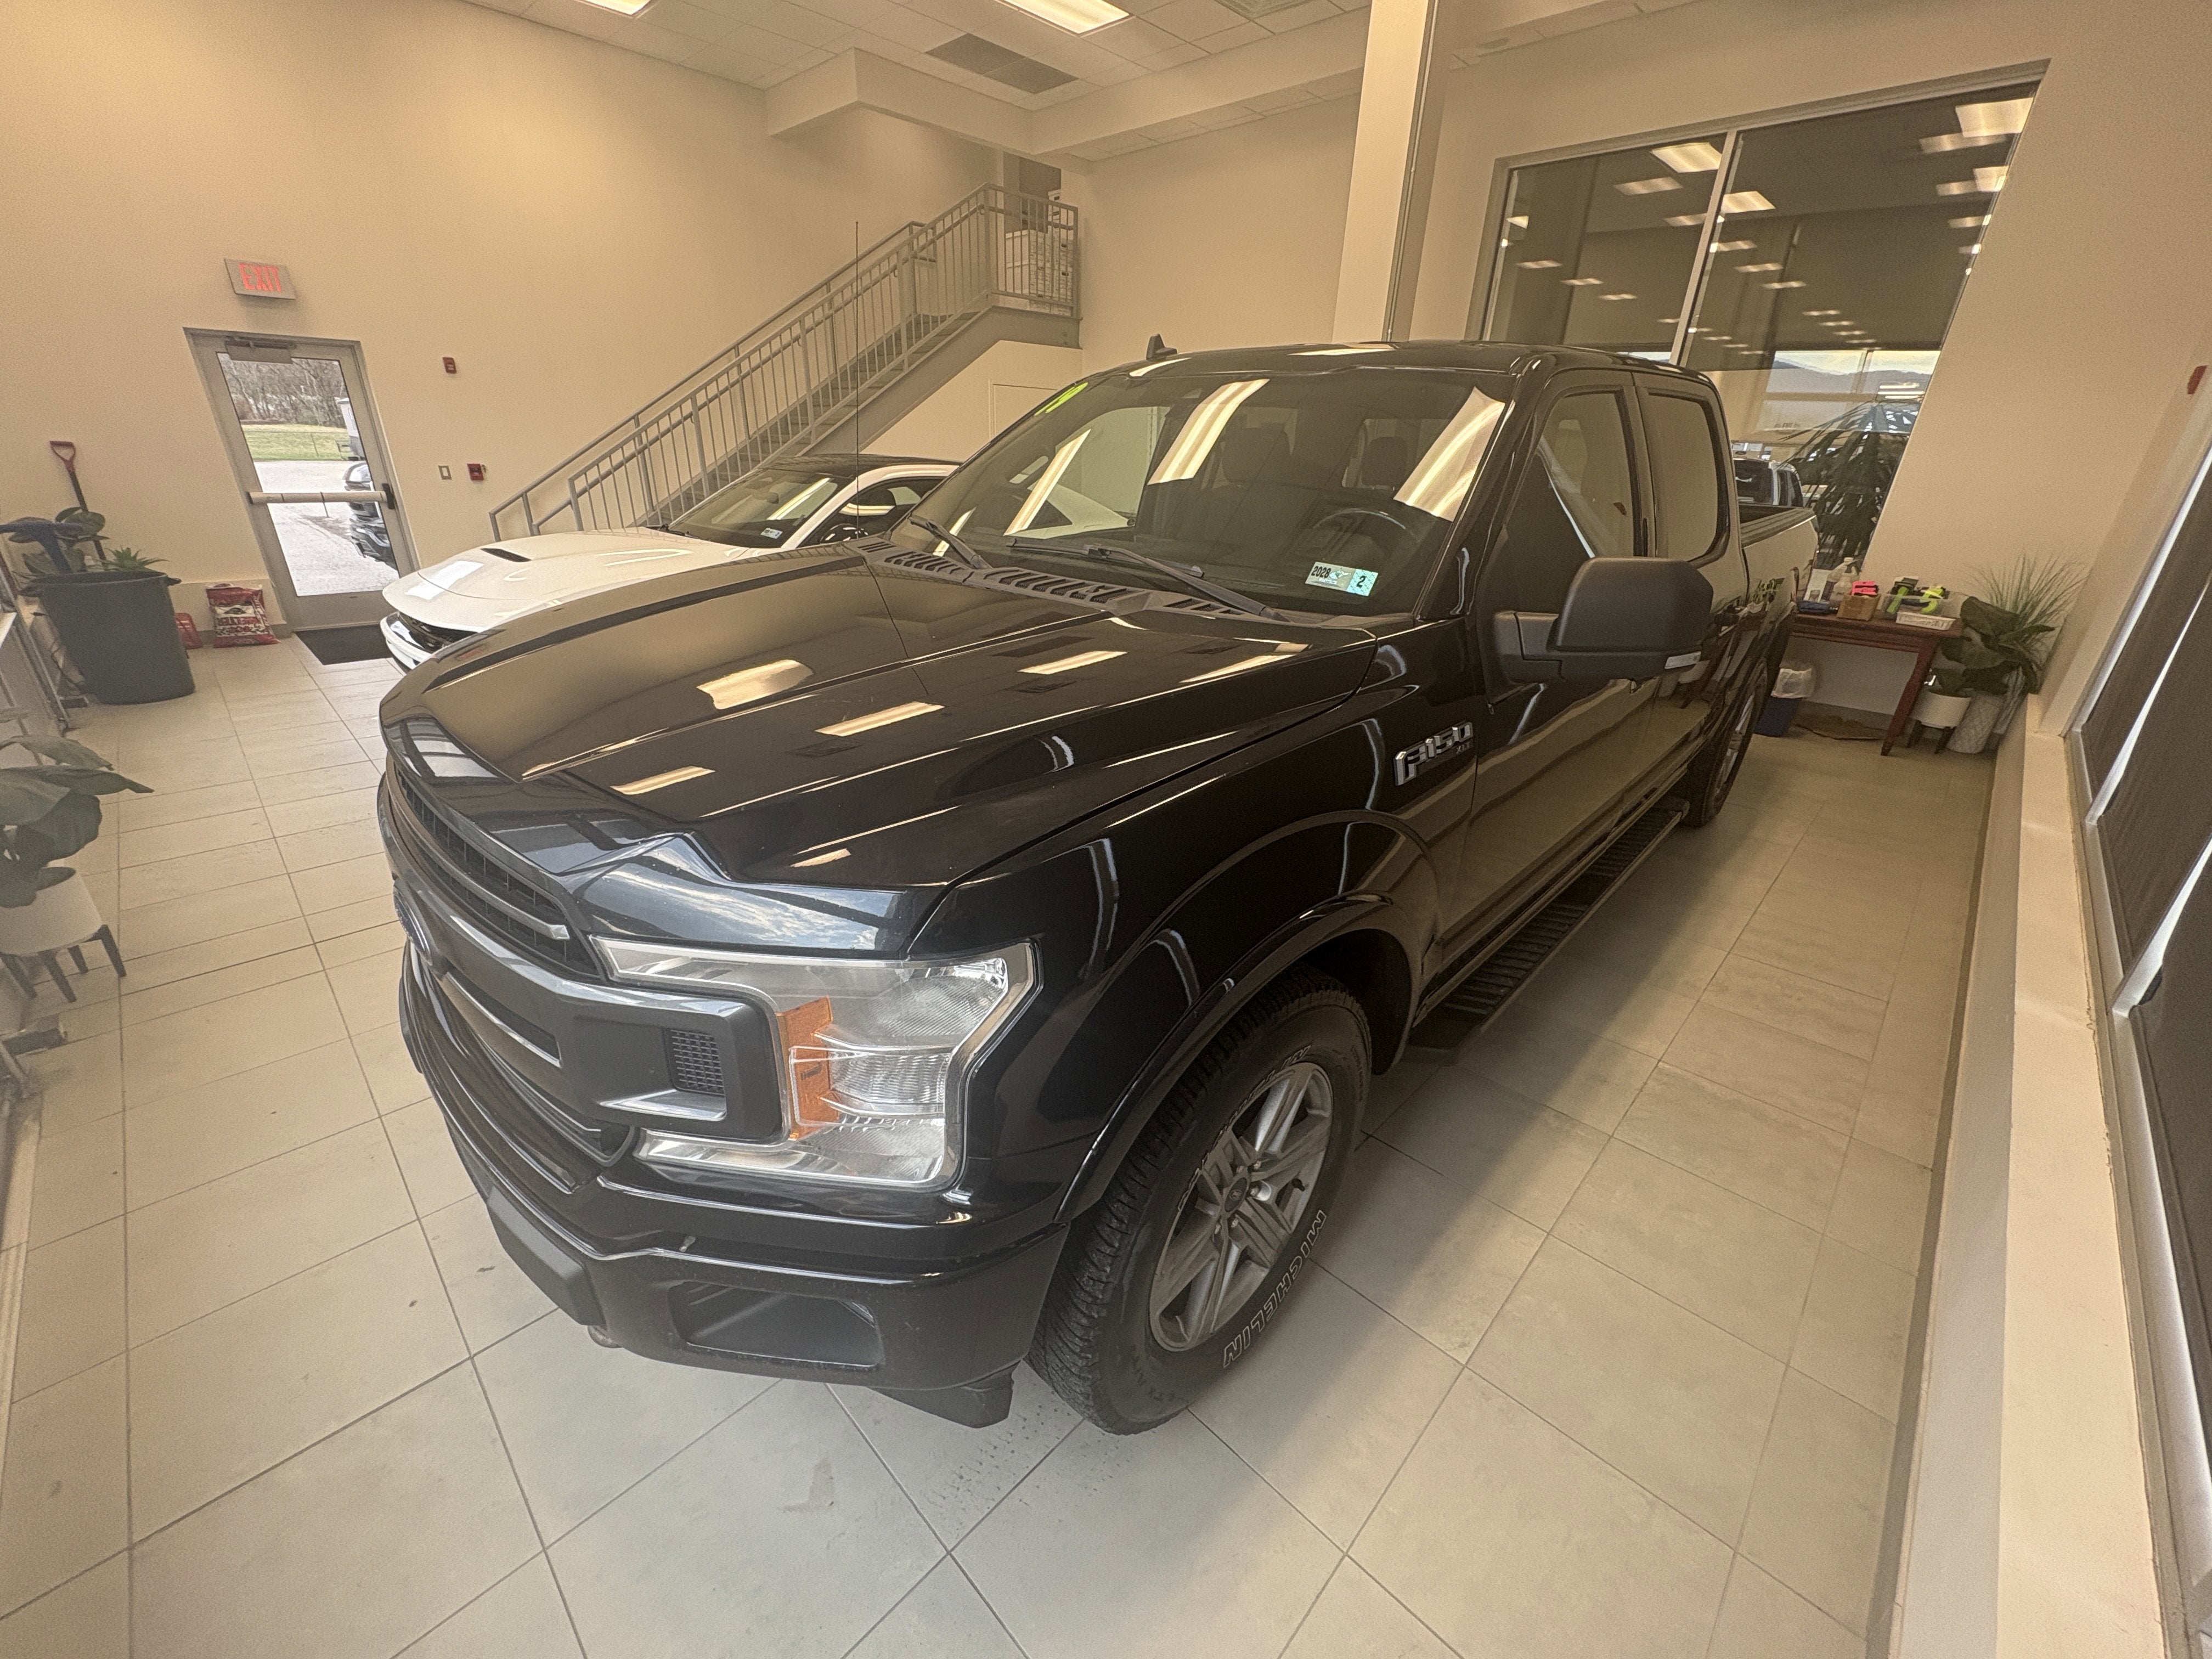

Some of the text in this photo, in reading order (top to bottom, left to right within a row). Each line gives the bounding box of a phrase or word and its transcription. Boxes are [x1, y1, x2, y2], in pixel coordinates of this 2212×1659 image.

[238, 263, 281, 292] EXIT
[1311, 566, 1331, 578] 2028
[1356, 575, 1367, 588] 2
[1223, 1210, 1327, 1368] MICHELIN
